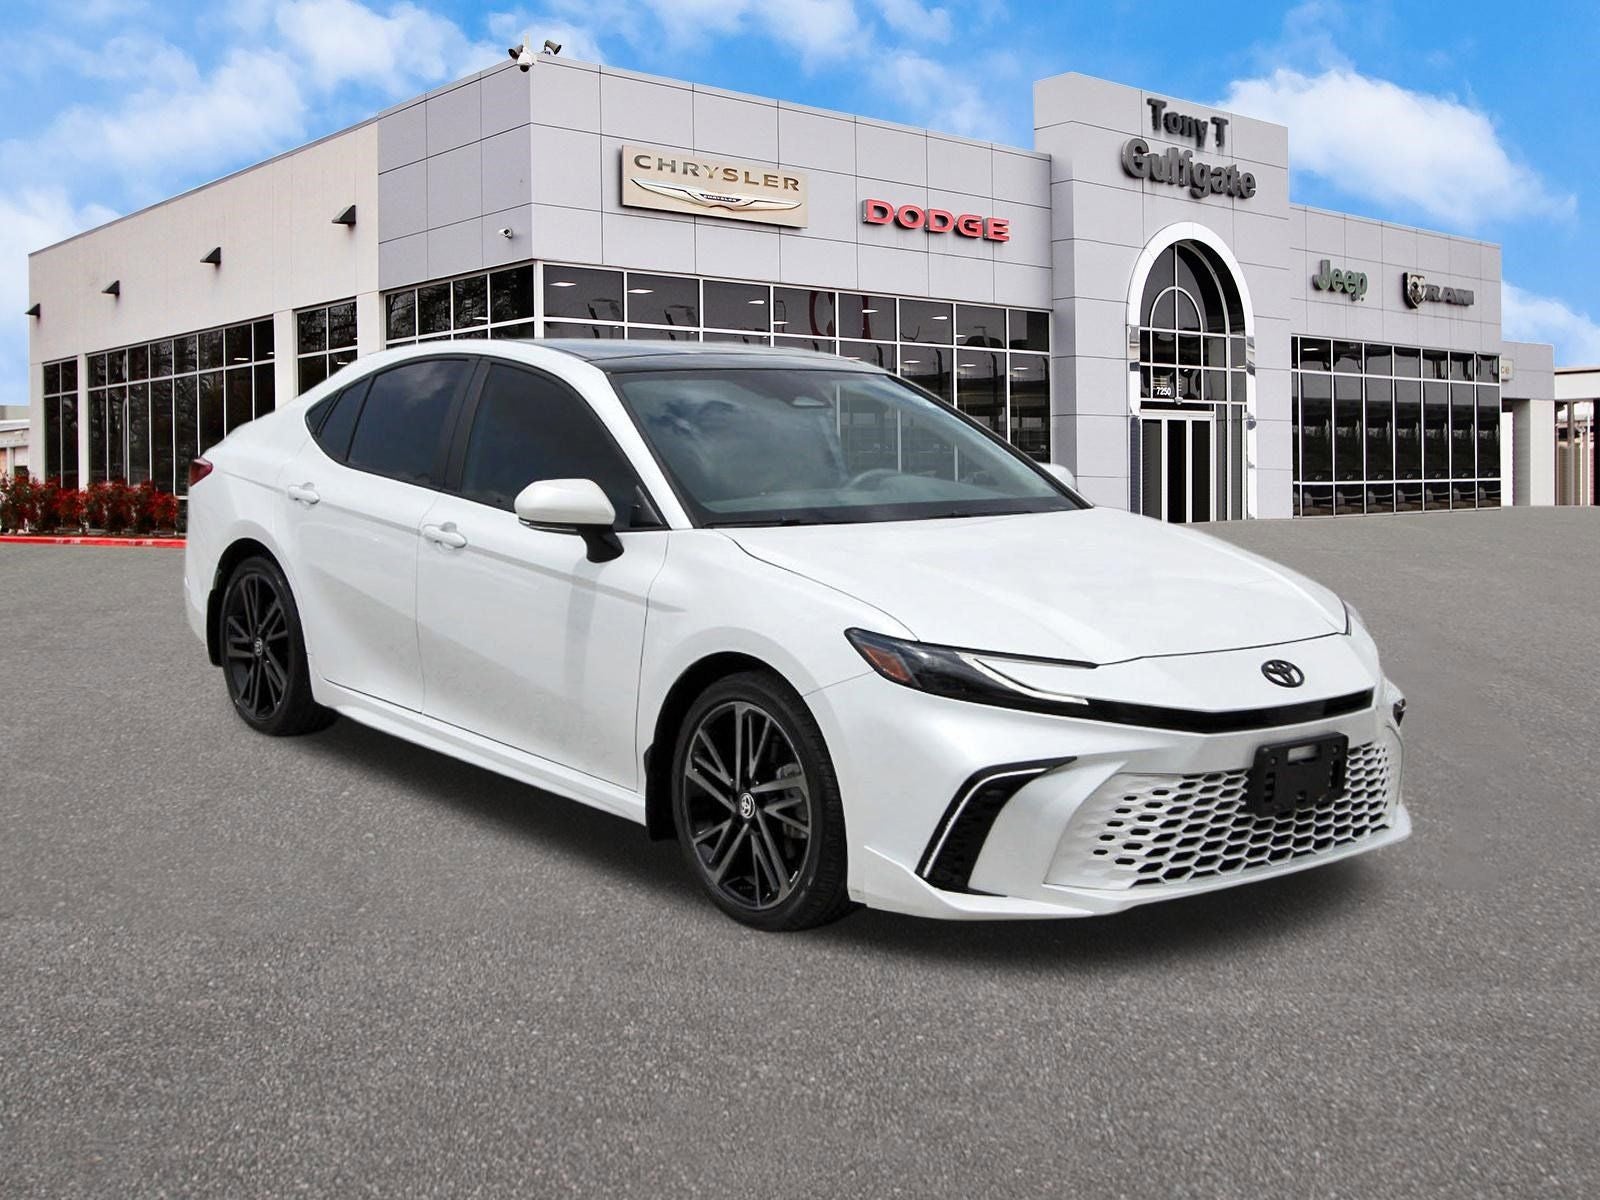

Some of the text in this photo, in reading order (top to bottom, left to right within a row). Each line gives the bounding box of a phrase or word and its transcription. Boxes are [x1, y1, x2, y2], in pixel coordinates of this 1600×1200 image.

[1147, 98, 1229, 147] Tony T
[634, 154, 800, 191] CHRYSLER
[1121, 138, 1256, 199] Gulfgate
[863, 198, 1010, 242] DODGE
[1313, 259, 1368, 301] Jeep
[1425, 284, 1475, 306] RAM
[1156, 387, 1172, 396] 7250
